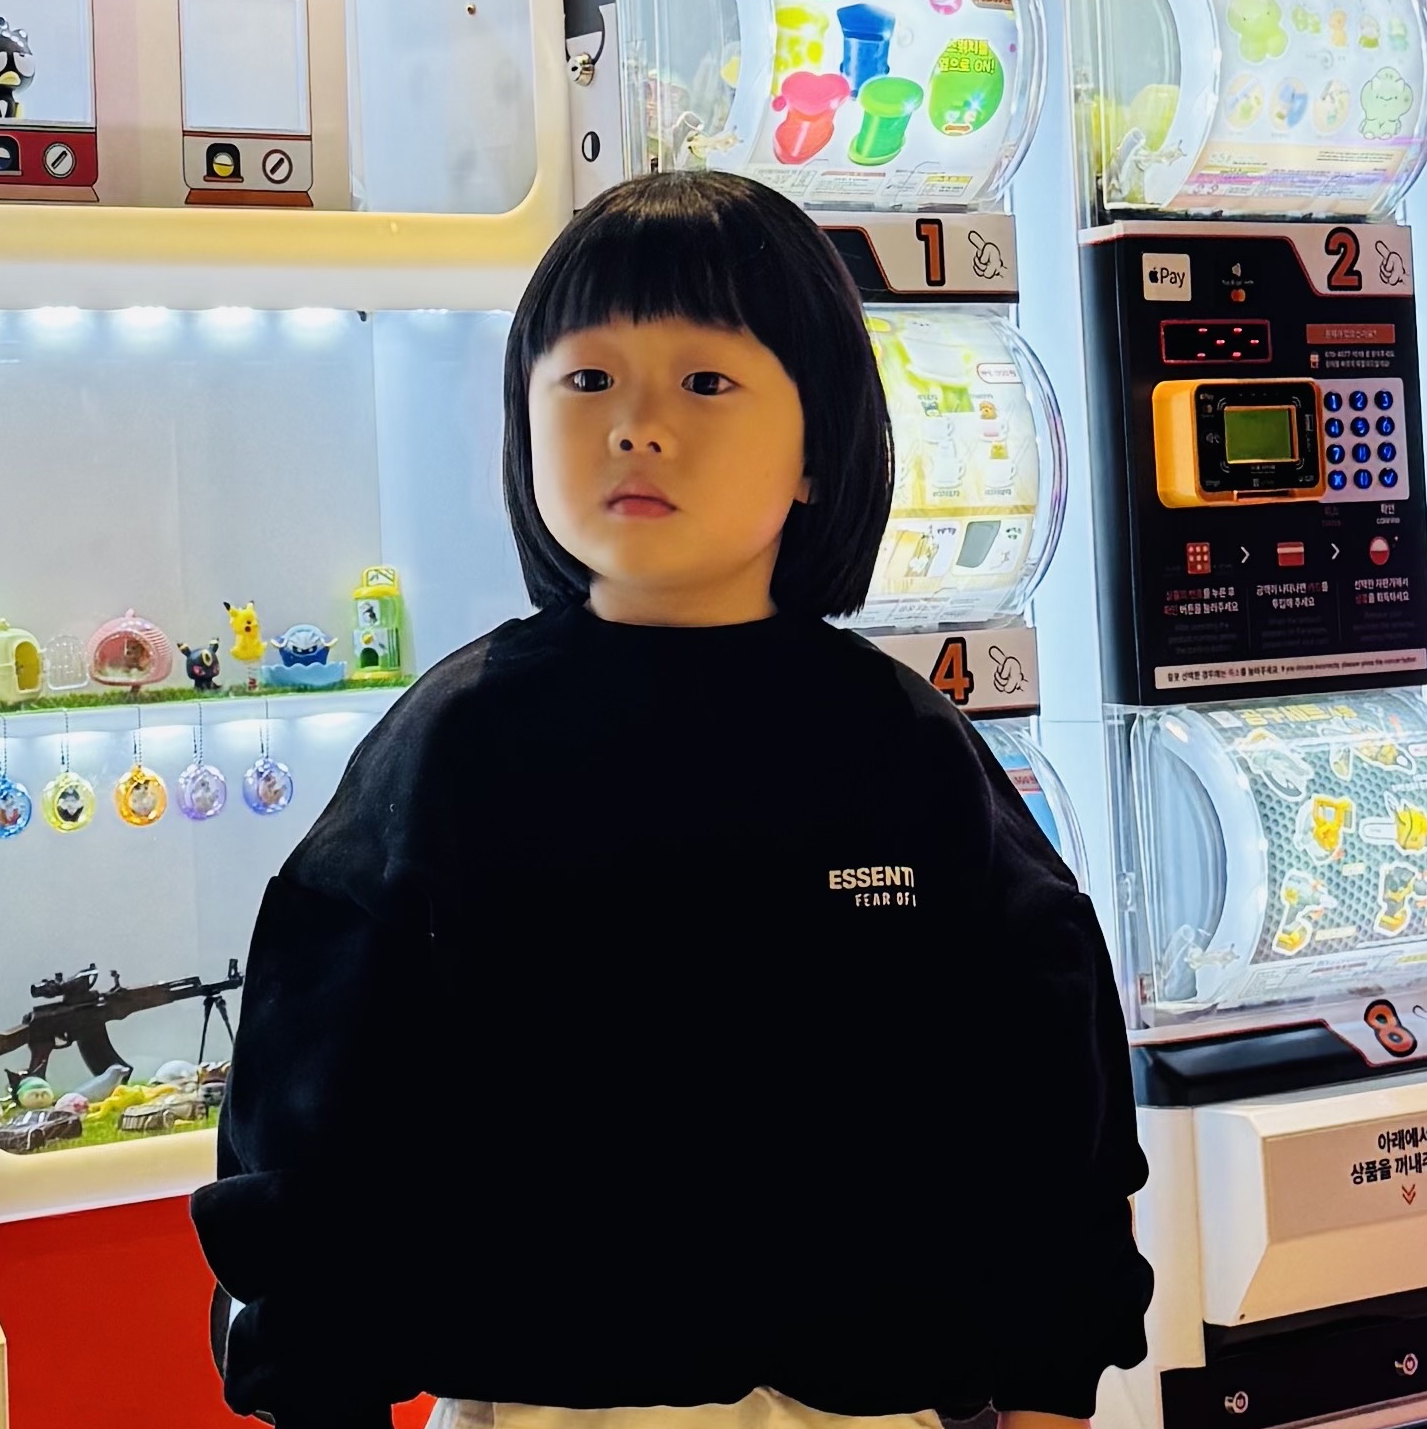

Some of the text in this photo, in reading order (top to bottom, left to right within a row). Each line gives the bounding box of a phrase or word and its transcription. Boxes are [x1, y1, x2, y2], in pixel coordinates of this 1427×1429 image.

[915, 217, 947, 286] 1
[1159, 267, 1186, 289] Pay
[1324, 226, 1363, 291] 2
[930, 635, 975, 705] 4
[855, 891, 891, 908] FEAR
[1364, 998, 1418, 1058] 8
[1350, 1155, 1392, 1187] 상품을
